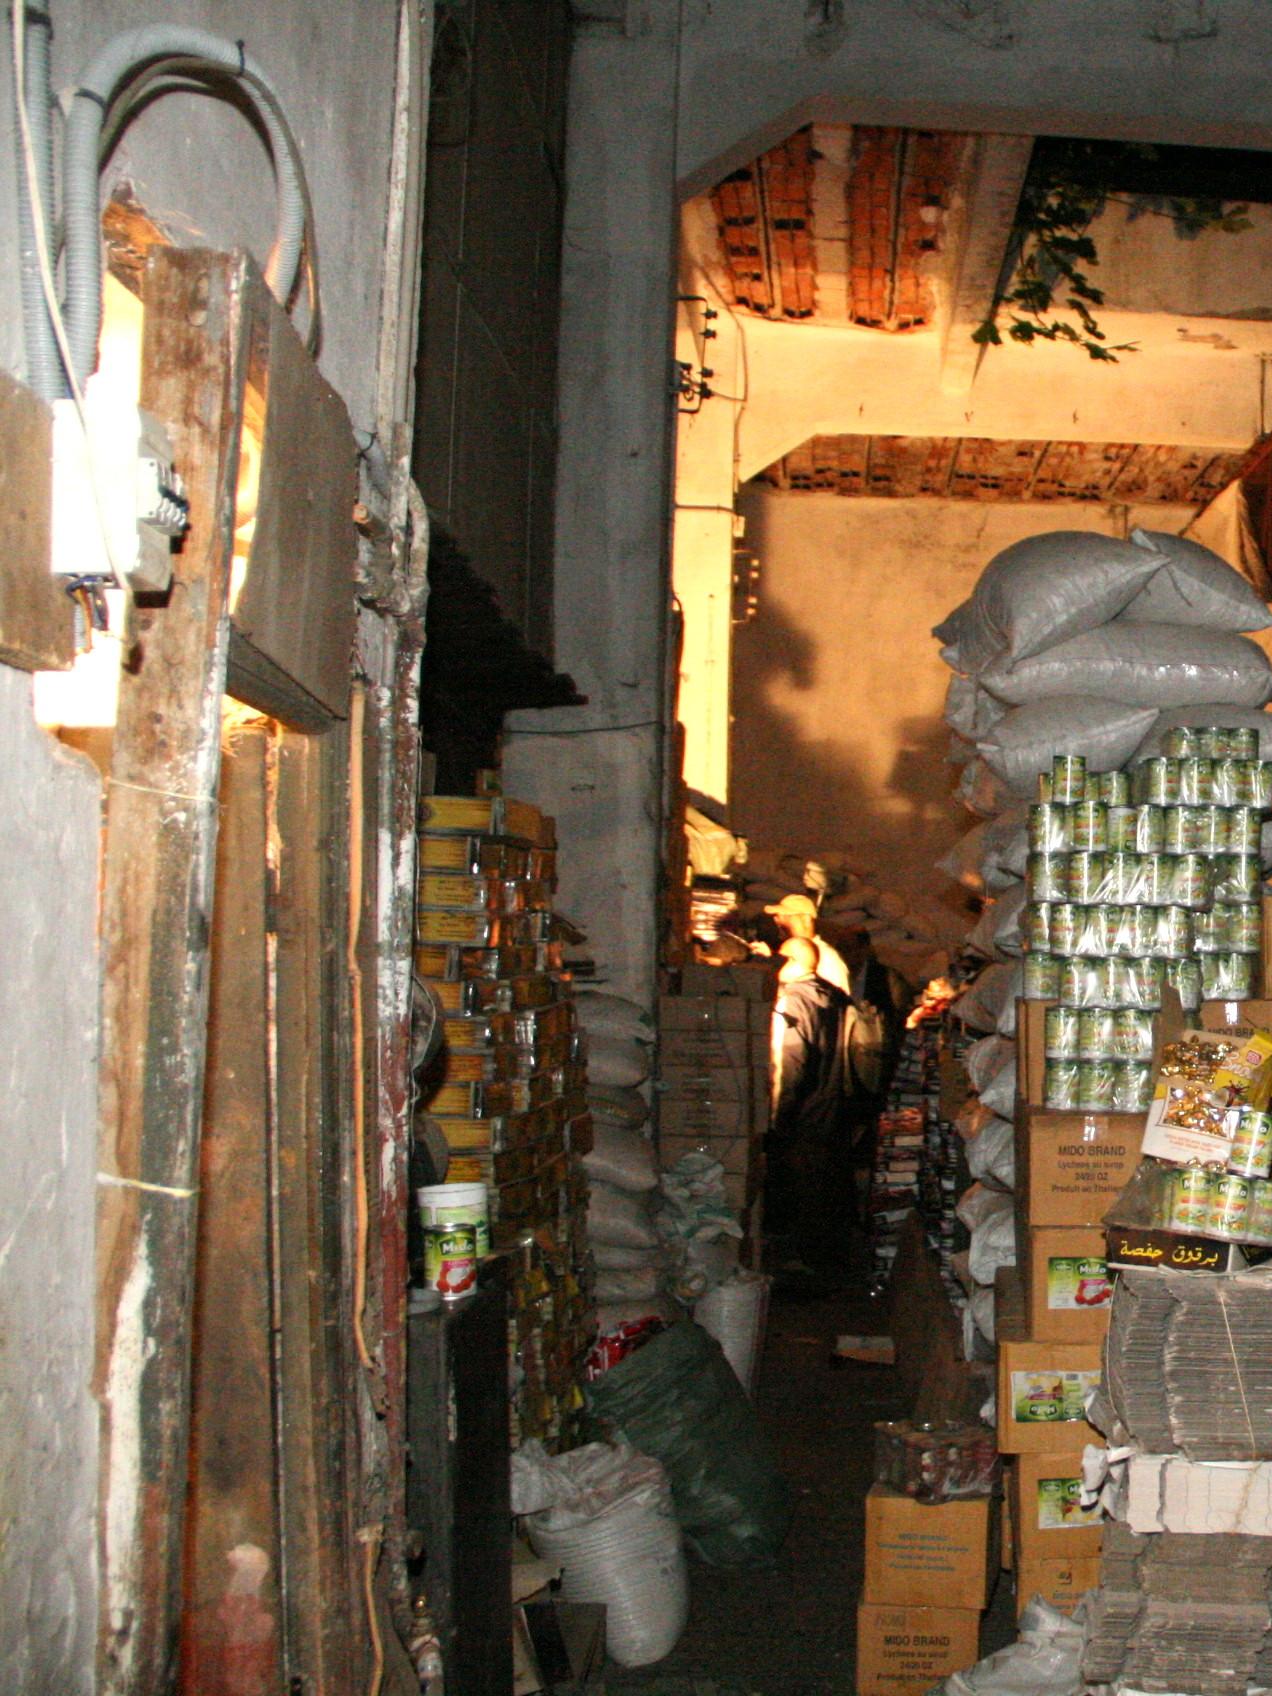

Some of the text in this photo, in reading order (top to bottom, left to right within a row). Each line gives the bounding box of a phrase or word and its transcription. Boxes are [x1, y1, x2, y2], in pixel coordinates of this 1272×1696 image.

[1058, 1145, 1126, 1156] MIDO BRAND
[1120, 1241, 1218, 1266] برقوق حفصة
[912, 1635, 950, 1647] BRAND
